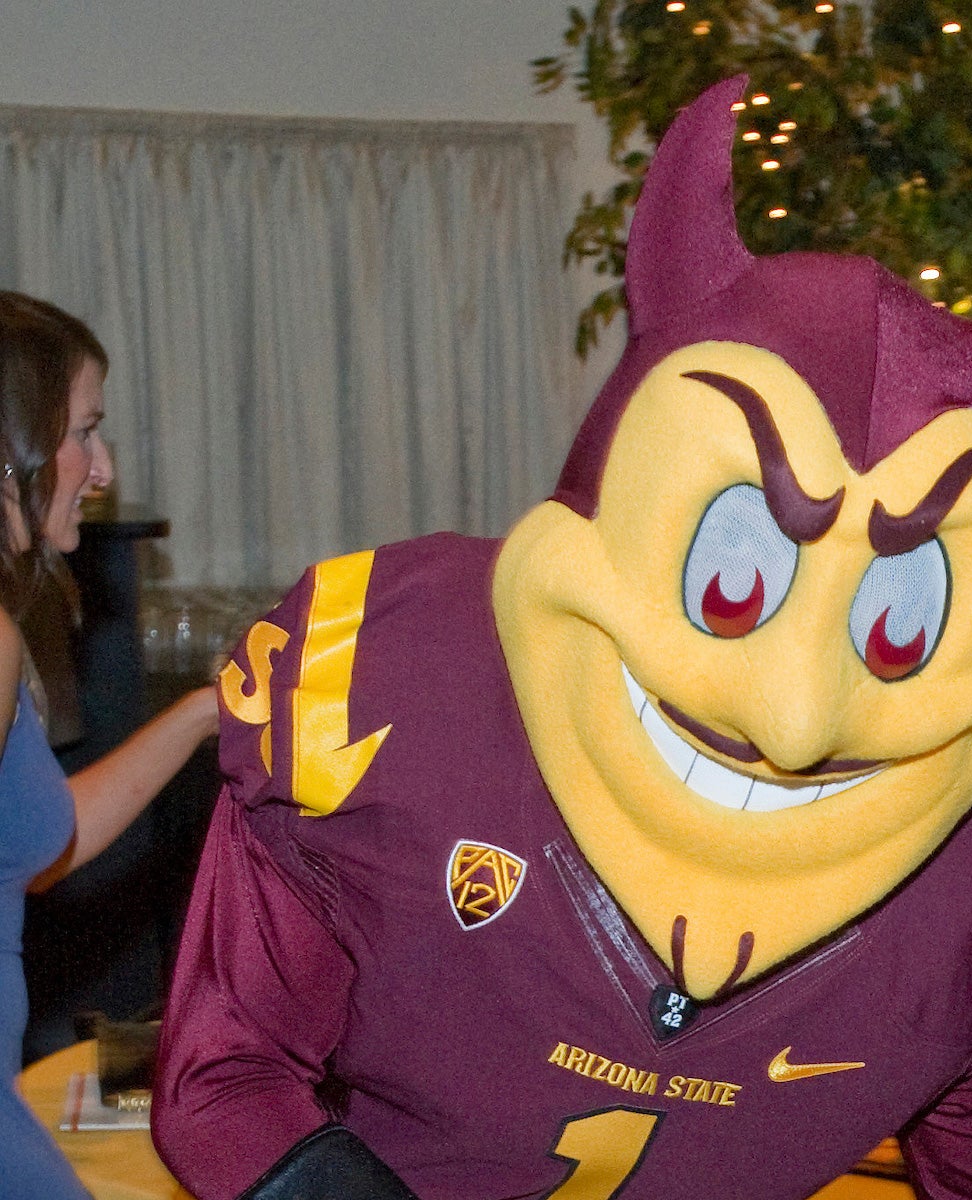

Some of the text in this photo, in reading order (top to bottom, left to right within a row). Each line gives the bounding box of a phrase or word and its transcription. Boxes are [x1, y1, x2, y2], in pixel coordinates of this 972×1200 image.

[219, 620, 290, 777] S
[457, 881, 497, 918] 12
[661, 1011, 683, 1028] 42
[667, 992, 689, 1010] PT
[547, 1041, 743, 1107] ARIZONA STATE
